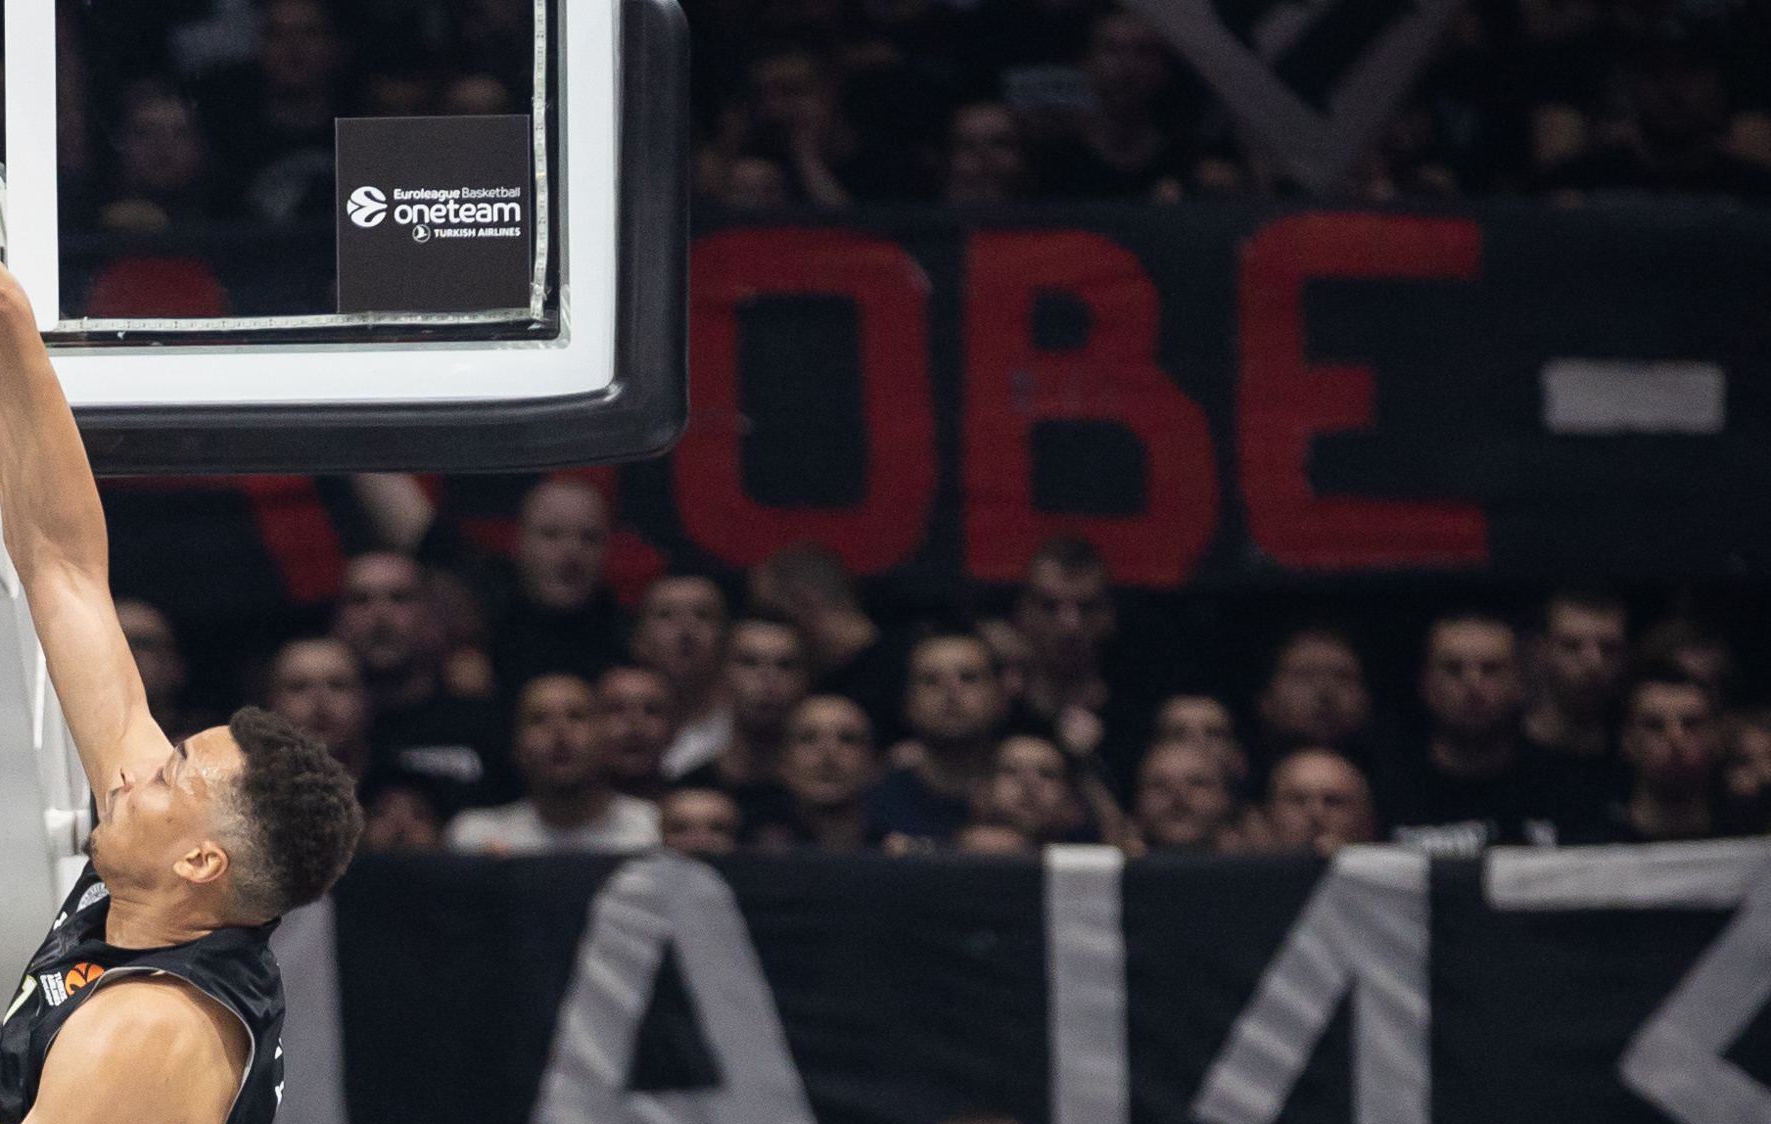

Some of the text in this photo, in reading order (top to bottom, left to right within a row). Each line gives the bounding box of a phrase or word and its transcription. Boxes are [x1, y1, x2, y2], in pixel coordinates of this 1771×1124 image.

[393, 187, 521, 202] Euroleague Basketball
[393, 199, 522, 225] oneteam
[433, 227, 522, 238] TURKISH AIRLINES
